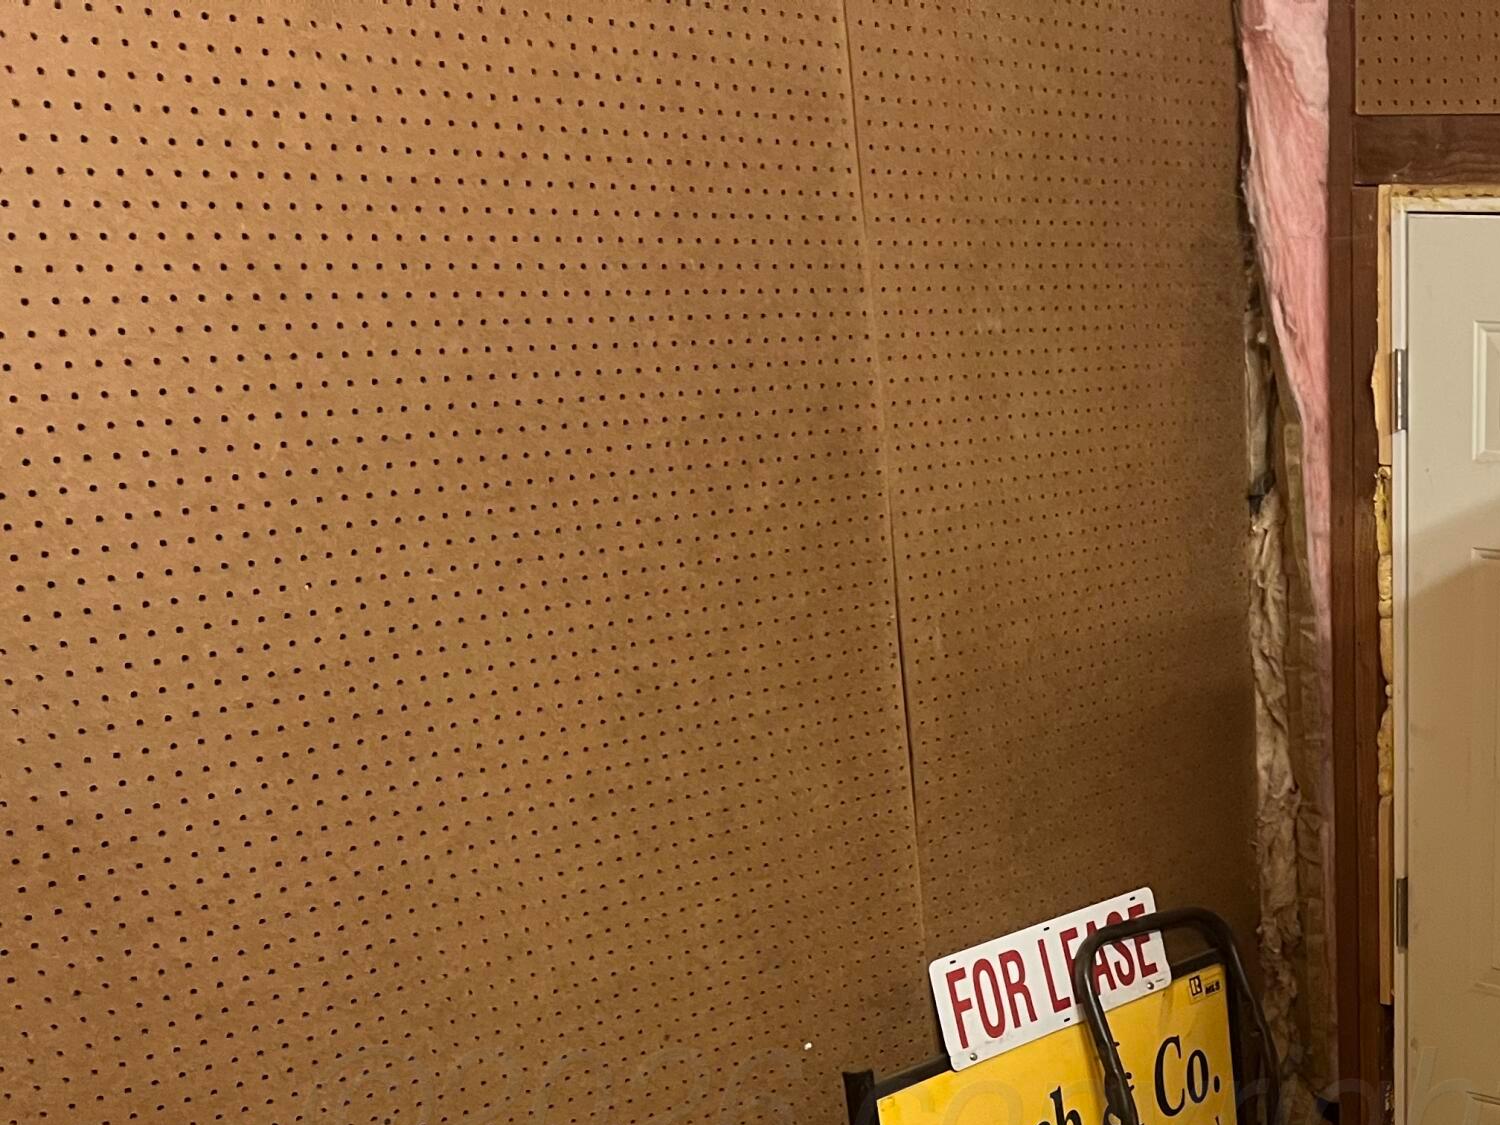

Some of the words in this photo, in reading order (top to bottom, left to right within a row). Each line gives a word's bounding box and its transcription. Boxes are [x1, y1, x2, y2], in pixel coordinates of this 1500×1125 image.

[946, 949, 1038, 1050] FOR
[1037, 903, 1158, 1014] LEASE
[1154, 1035, 1221, 1117] Co.
